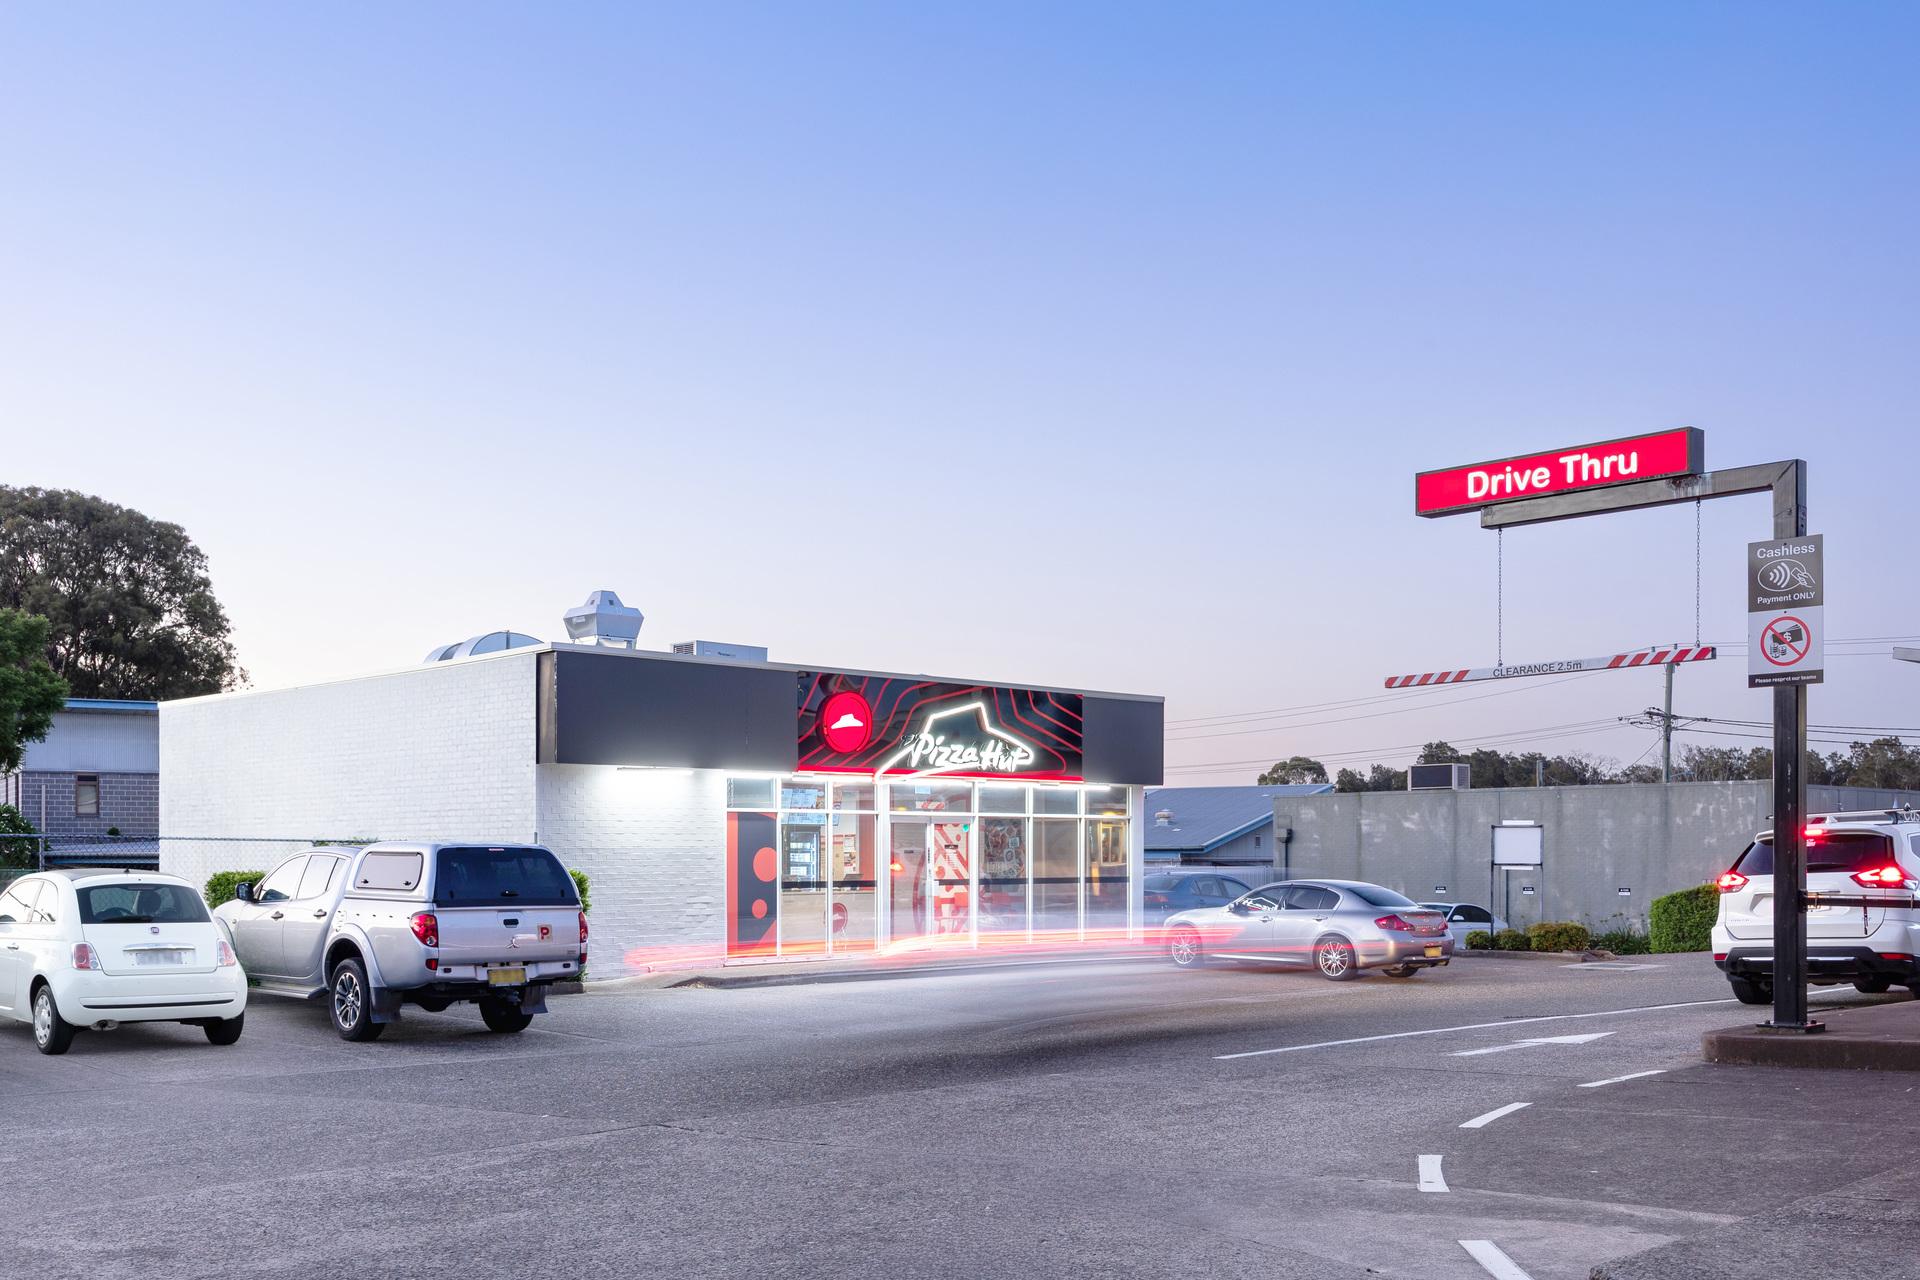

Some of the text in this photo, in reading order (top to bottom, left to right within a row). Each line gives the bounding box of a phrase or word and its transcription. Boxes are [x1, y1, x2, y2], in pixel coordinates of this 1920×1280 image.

[1467, 452, 1637, 498] Drive Thru
[1756, 544, 1815, 558] Cashless
[1757, 592, 1815, 604] Payment ONLY
[1493, 661, 1582, 676] CLEARANCE 2.5m
[909, 733, 1026, 772] Pizza Hut
[540, 926, 550, 939] P
